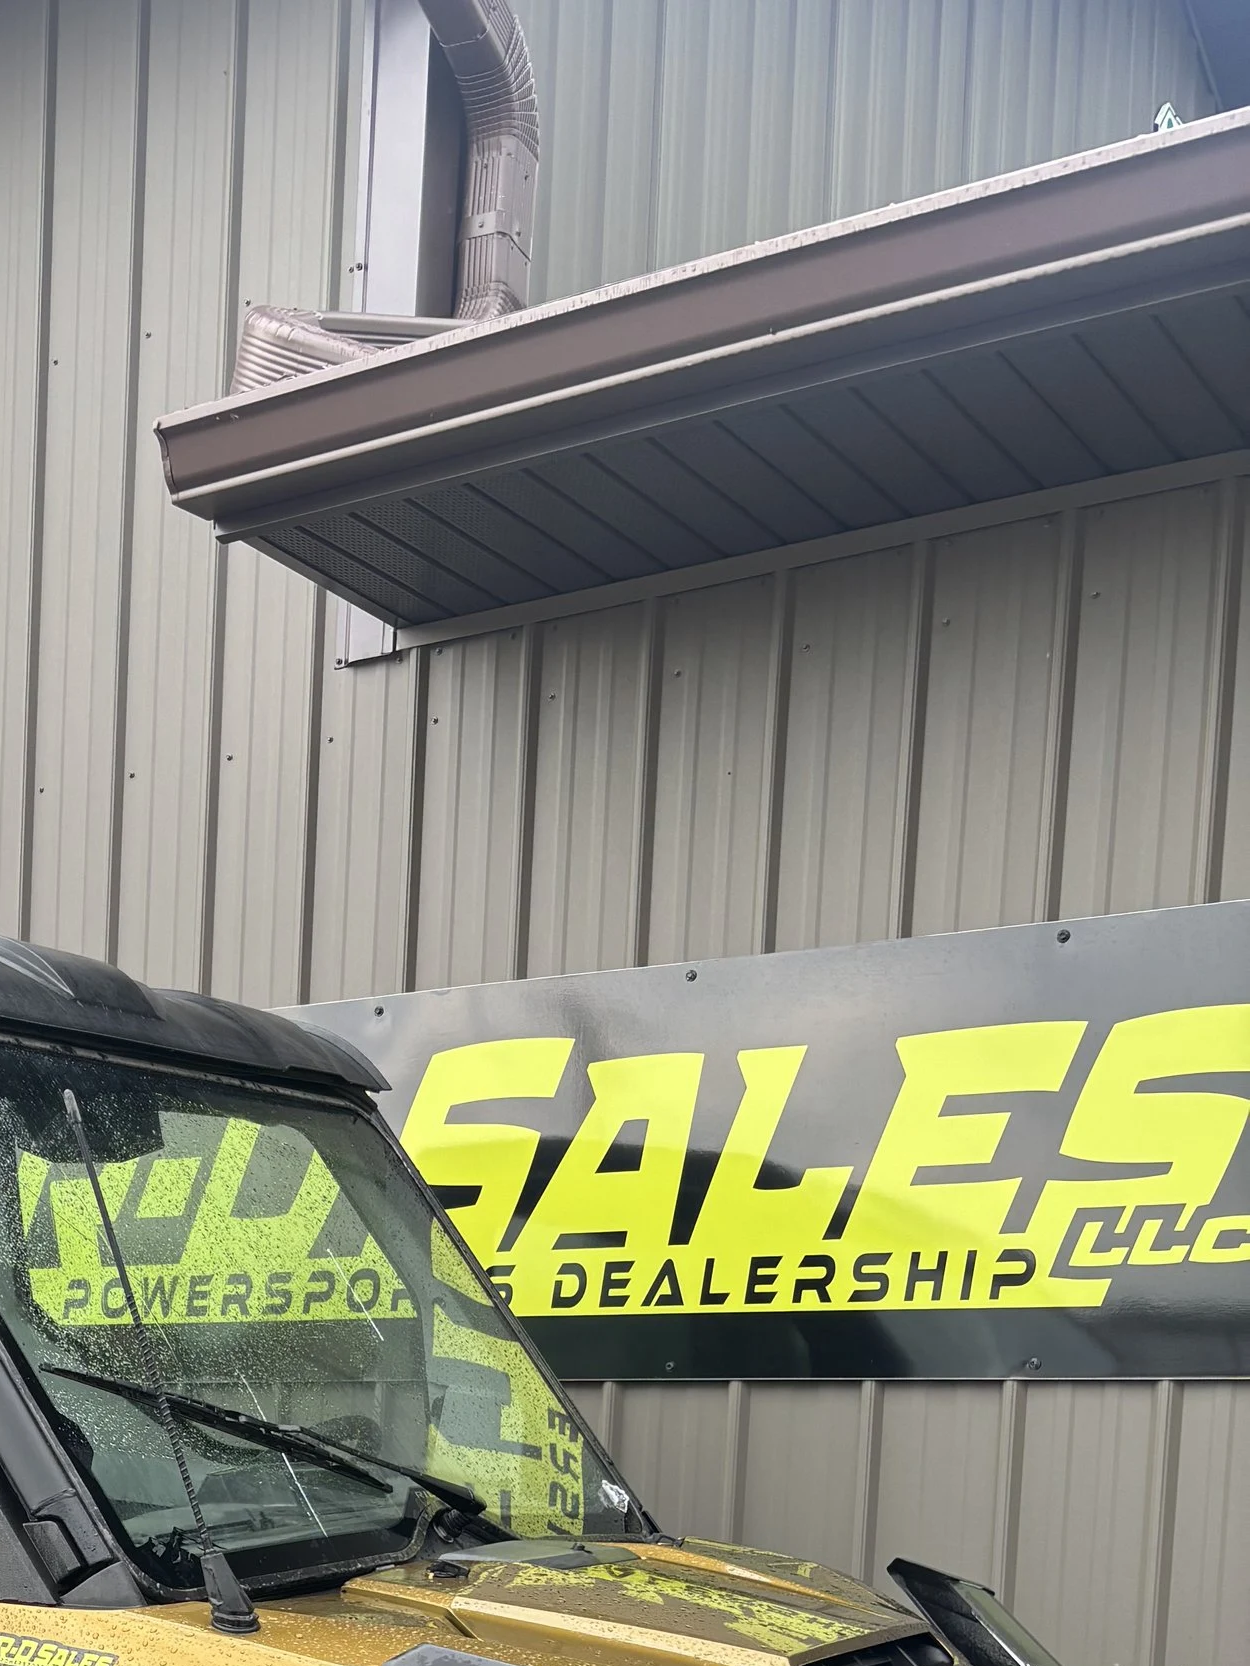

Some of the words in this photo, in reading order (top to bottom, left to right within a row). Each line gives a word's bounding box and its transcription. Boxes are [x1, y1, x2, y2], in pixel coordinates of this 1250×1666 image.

[402, 1003, 1250, 1250] SALES
[1068, 1214, 1250, 1268] LLC
[552, 1250, 1035, 1308] DEALERSHIP
